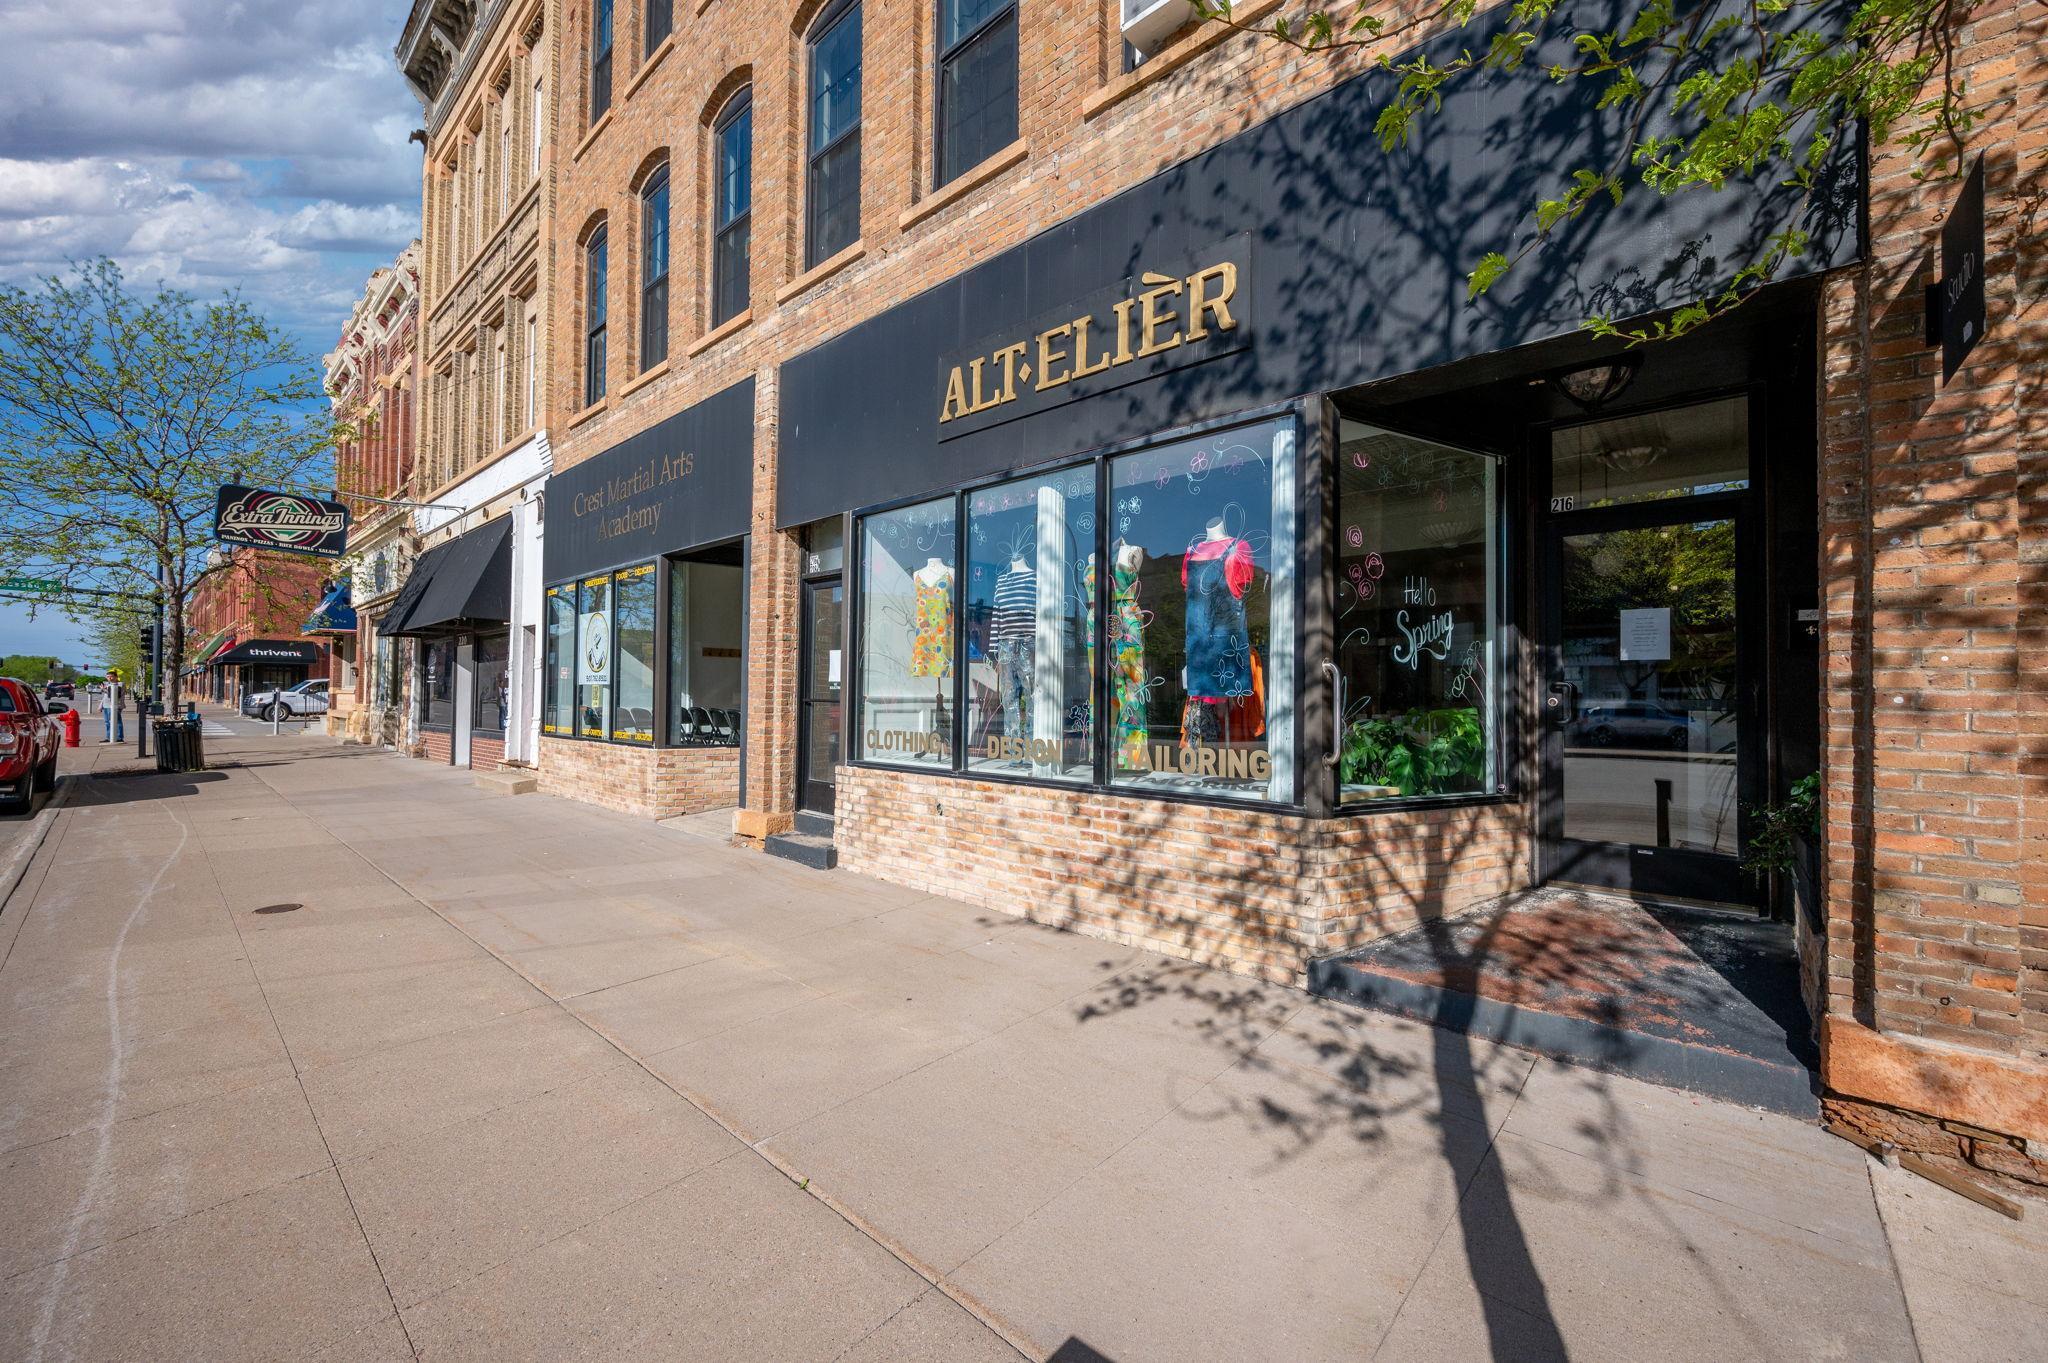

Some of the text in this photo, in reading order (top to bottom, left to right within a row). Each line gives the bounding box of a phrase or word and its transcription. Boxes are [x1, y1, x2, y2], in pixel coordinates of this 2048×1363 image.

[574, 450, 694, 517] Crest Martial Arts
[226, 504, 341, 532] Extra Innings
[1551, 497, 1573, 512] 216
[597, 501, 662, 541] Academy
[221, 534, 248, 542] PANINOS
[253, 538, 274, 546] PIZZAS
[1404, 575, 1436, 607] Hello
[249, 648, 302, 657] thrivent
[1393, 609, 1455, 671] Spring
[866, 729, 942, 753] CLOTHING
[987, 735, 1062, 766] DESIGN
[1122, 744, 1272, 781] TAILORING
